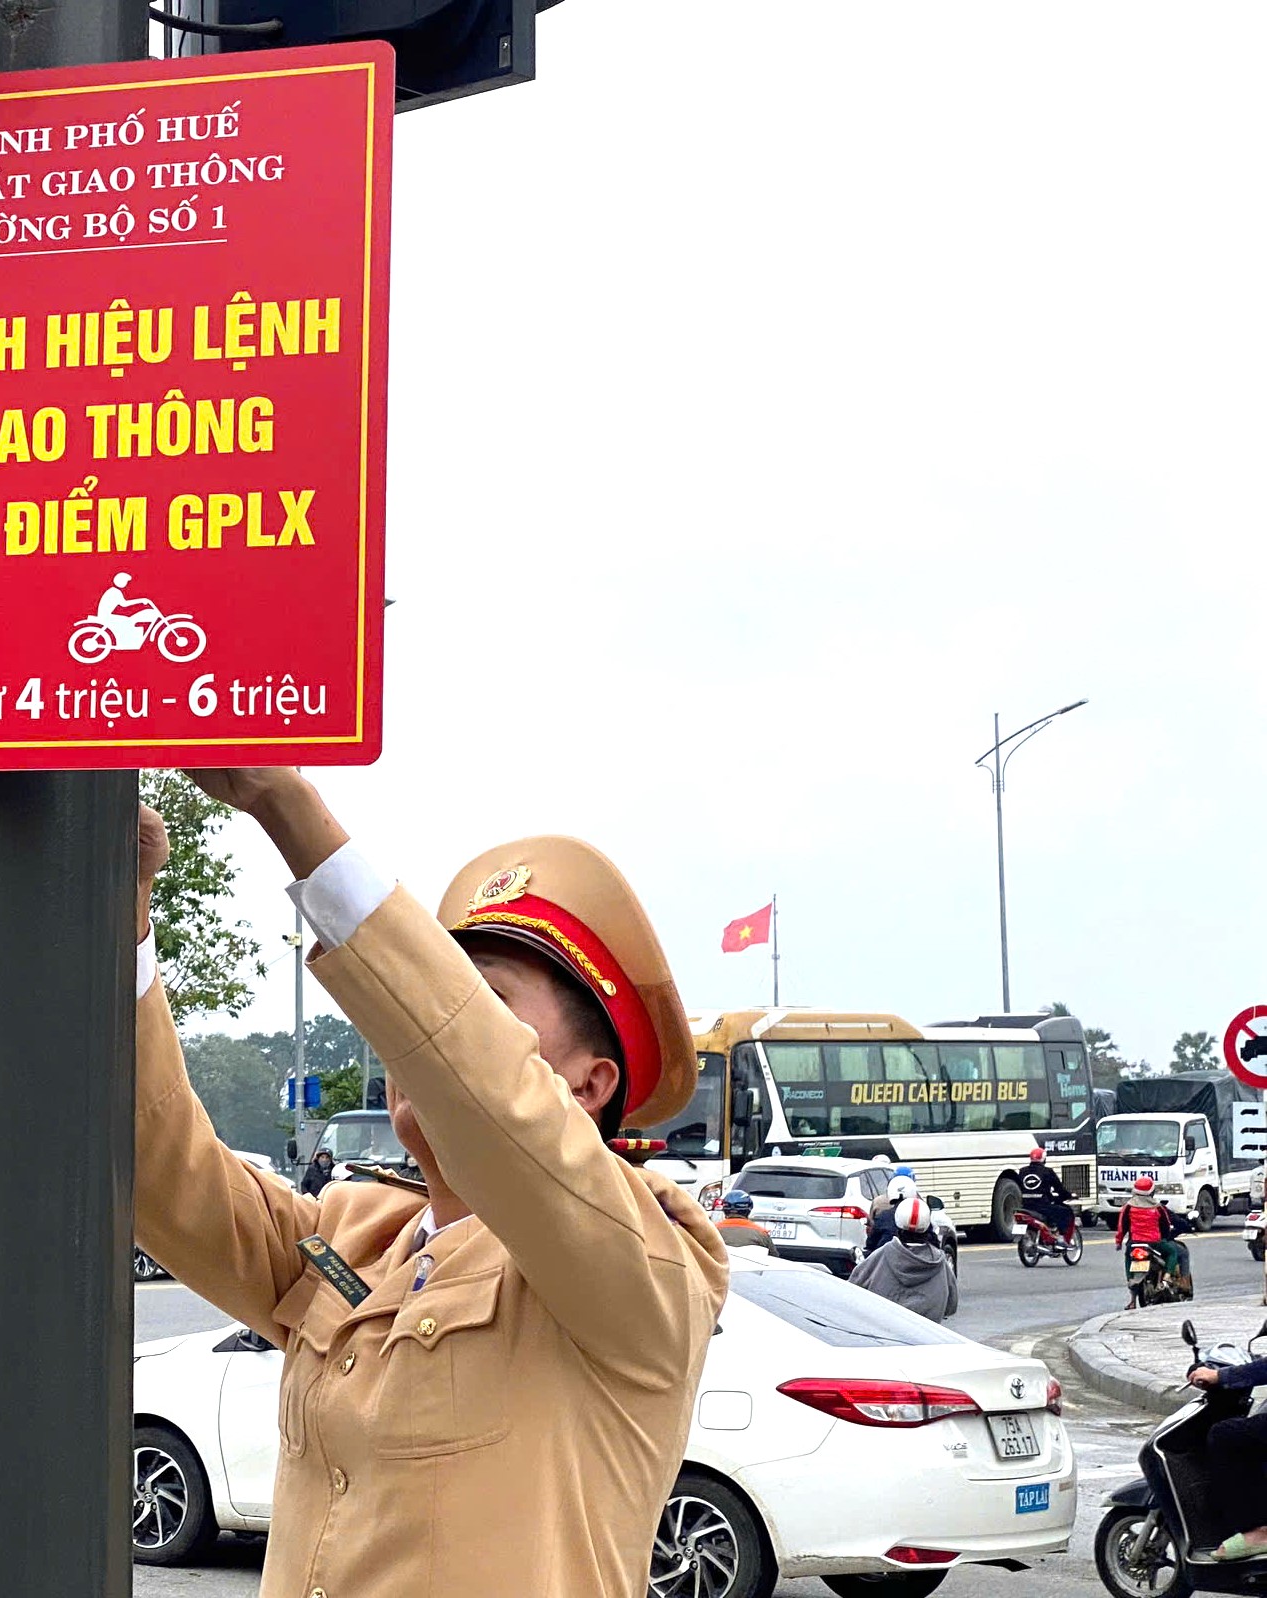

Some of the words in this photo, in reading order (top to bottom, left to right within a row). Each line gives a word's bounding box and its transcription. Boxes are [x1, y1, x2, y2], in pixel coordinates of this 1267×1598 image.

[64, 108, 145, 149] PHỐ
[157, 100, 241, 142] HUẾ
[42, 167, 135, 196] GIAO
[147, 153, 285, 188] THÔNG
[83, 204, 135, 241] BỘ
[148, 194, 199, 234] SỐ
[212, 205, 227, 229] 1
[46, 298, 173, 377] HIỆU
[193, 291, 341, 371] LỆNH
[85, 389, 274, 459] THÔNG
[4, 475, 148, 556] ĐIỂM
[168, 490, 316, 550] GPLX
[15, 677, 44, 719] 4
[55, 679, 148, 728] triệu
[188, 673, 218, 717] 6
[230, 674, 326, 725] triệu
[850, 1083, 904, 1105] QUEEN
[908, 1083, 948, 1103] CAFE
[951, 1082, 992, 1102] OPEN
[997, 1081, 1028, 1101] BUS
[1100, 1168, 1137, 1181] THÀNH
[1001, 1416, 1022, 1434] 75A
[1001, 1435, 1036, 1456] 263.17
